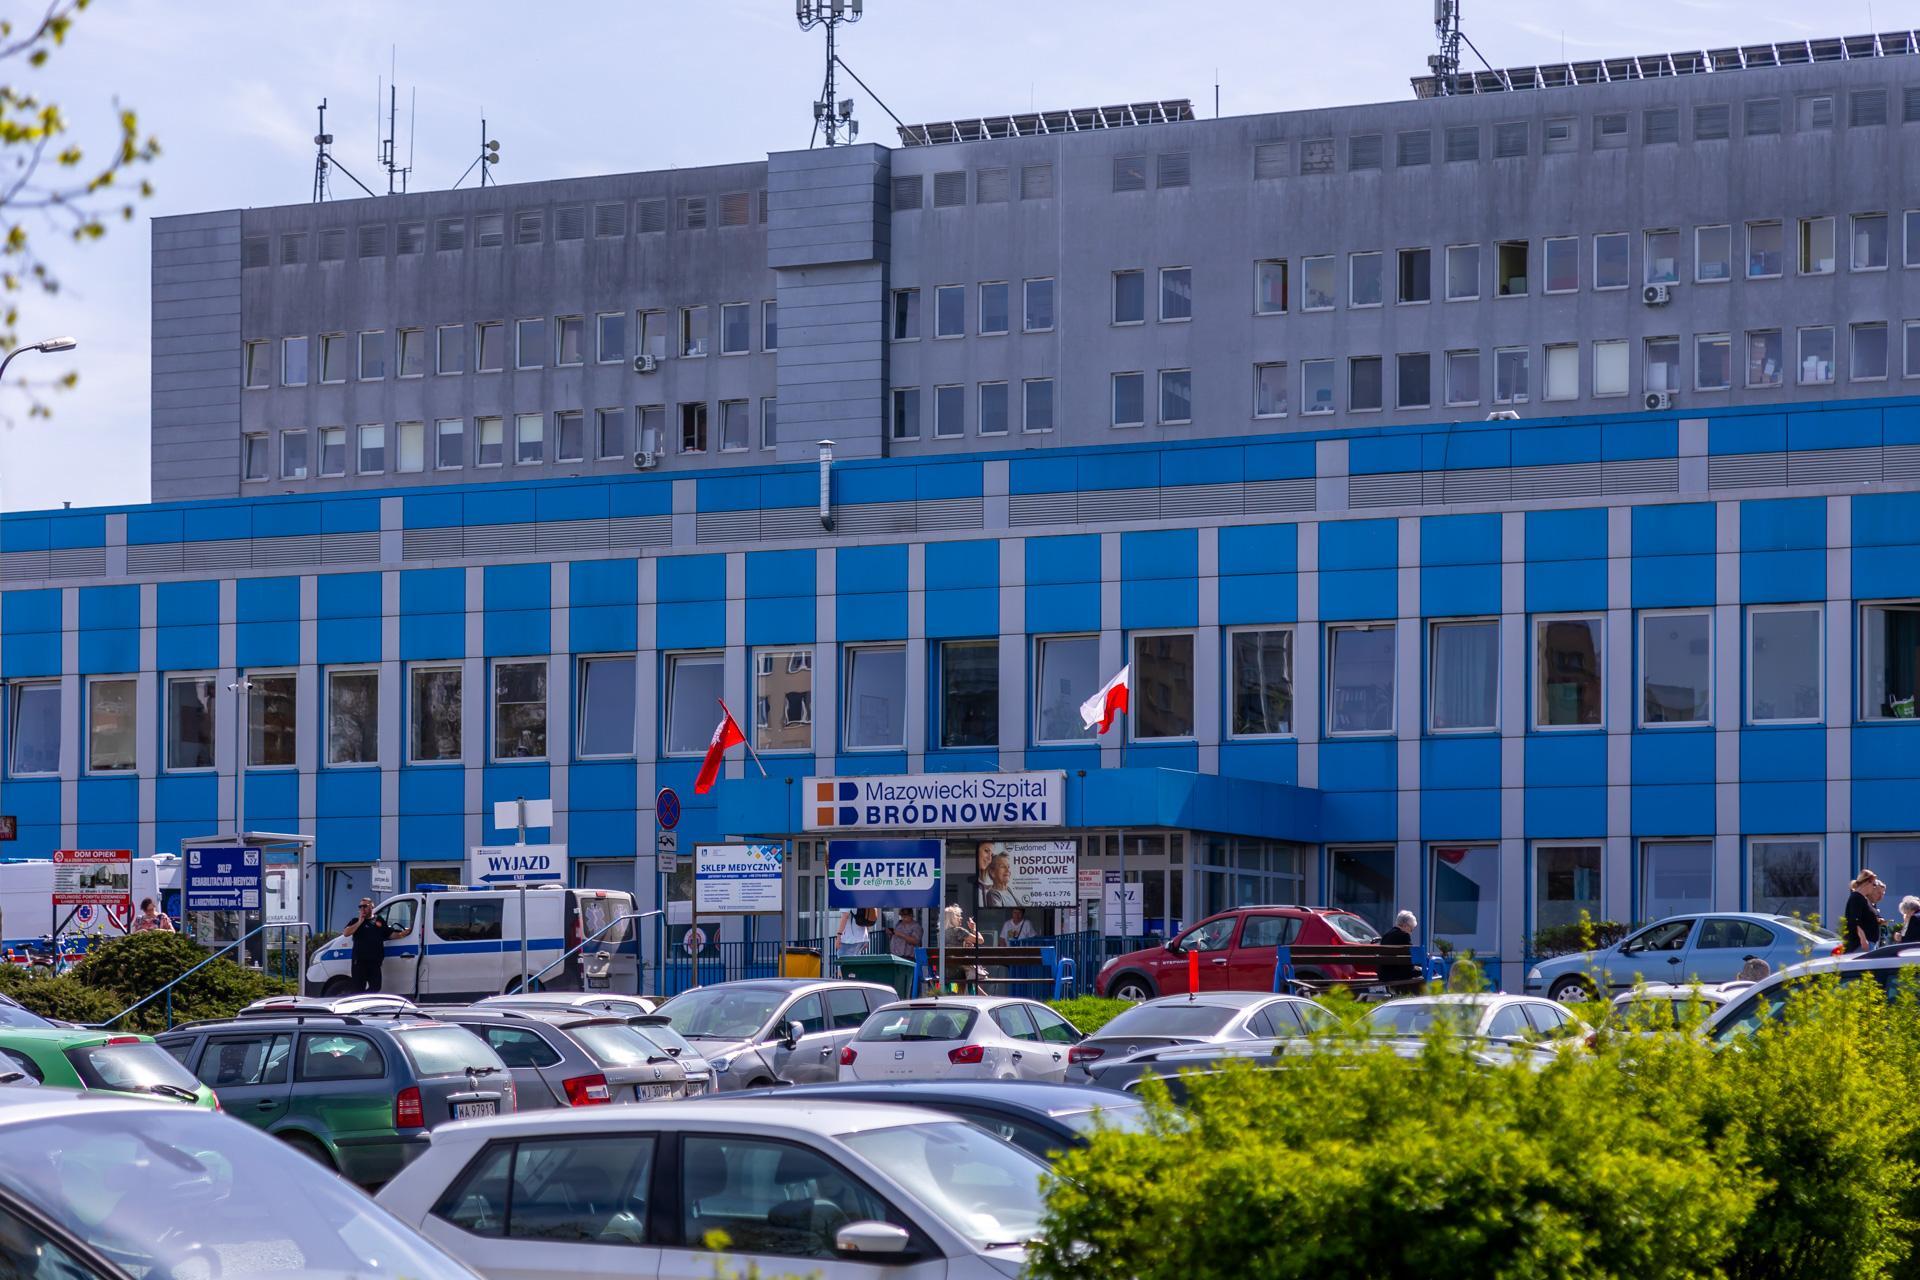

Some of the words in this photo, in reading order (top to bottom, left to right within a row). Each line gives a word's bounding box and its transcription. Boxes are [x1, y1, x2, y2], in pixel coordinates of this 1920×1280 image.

[866, 779, 978, 801] Mazowiecki
[983, 777, 1047, 802] Szpital
[866, 801, 1047, 825] BRÓDNOWSKI
[1014, 844, 1047, 852] Ewdomed
[488, 855, 550, 871] WYJAZD
[1013, 855, 1075, 865] HOSPICJUM
[217, 863, 232, 874] SKLEP
[701, 864, 726, 872] SKLEP
[728, 863, 776, 871] MEDYCZNY
[863, 862, 928, 878] APTEKA
[1019, 865, 1068, 875] DOMOWE
[863, 878, 893, 887] cef@rm
[895, 878, 912, 887] 36,6
